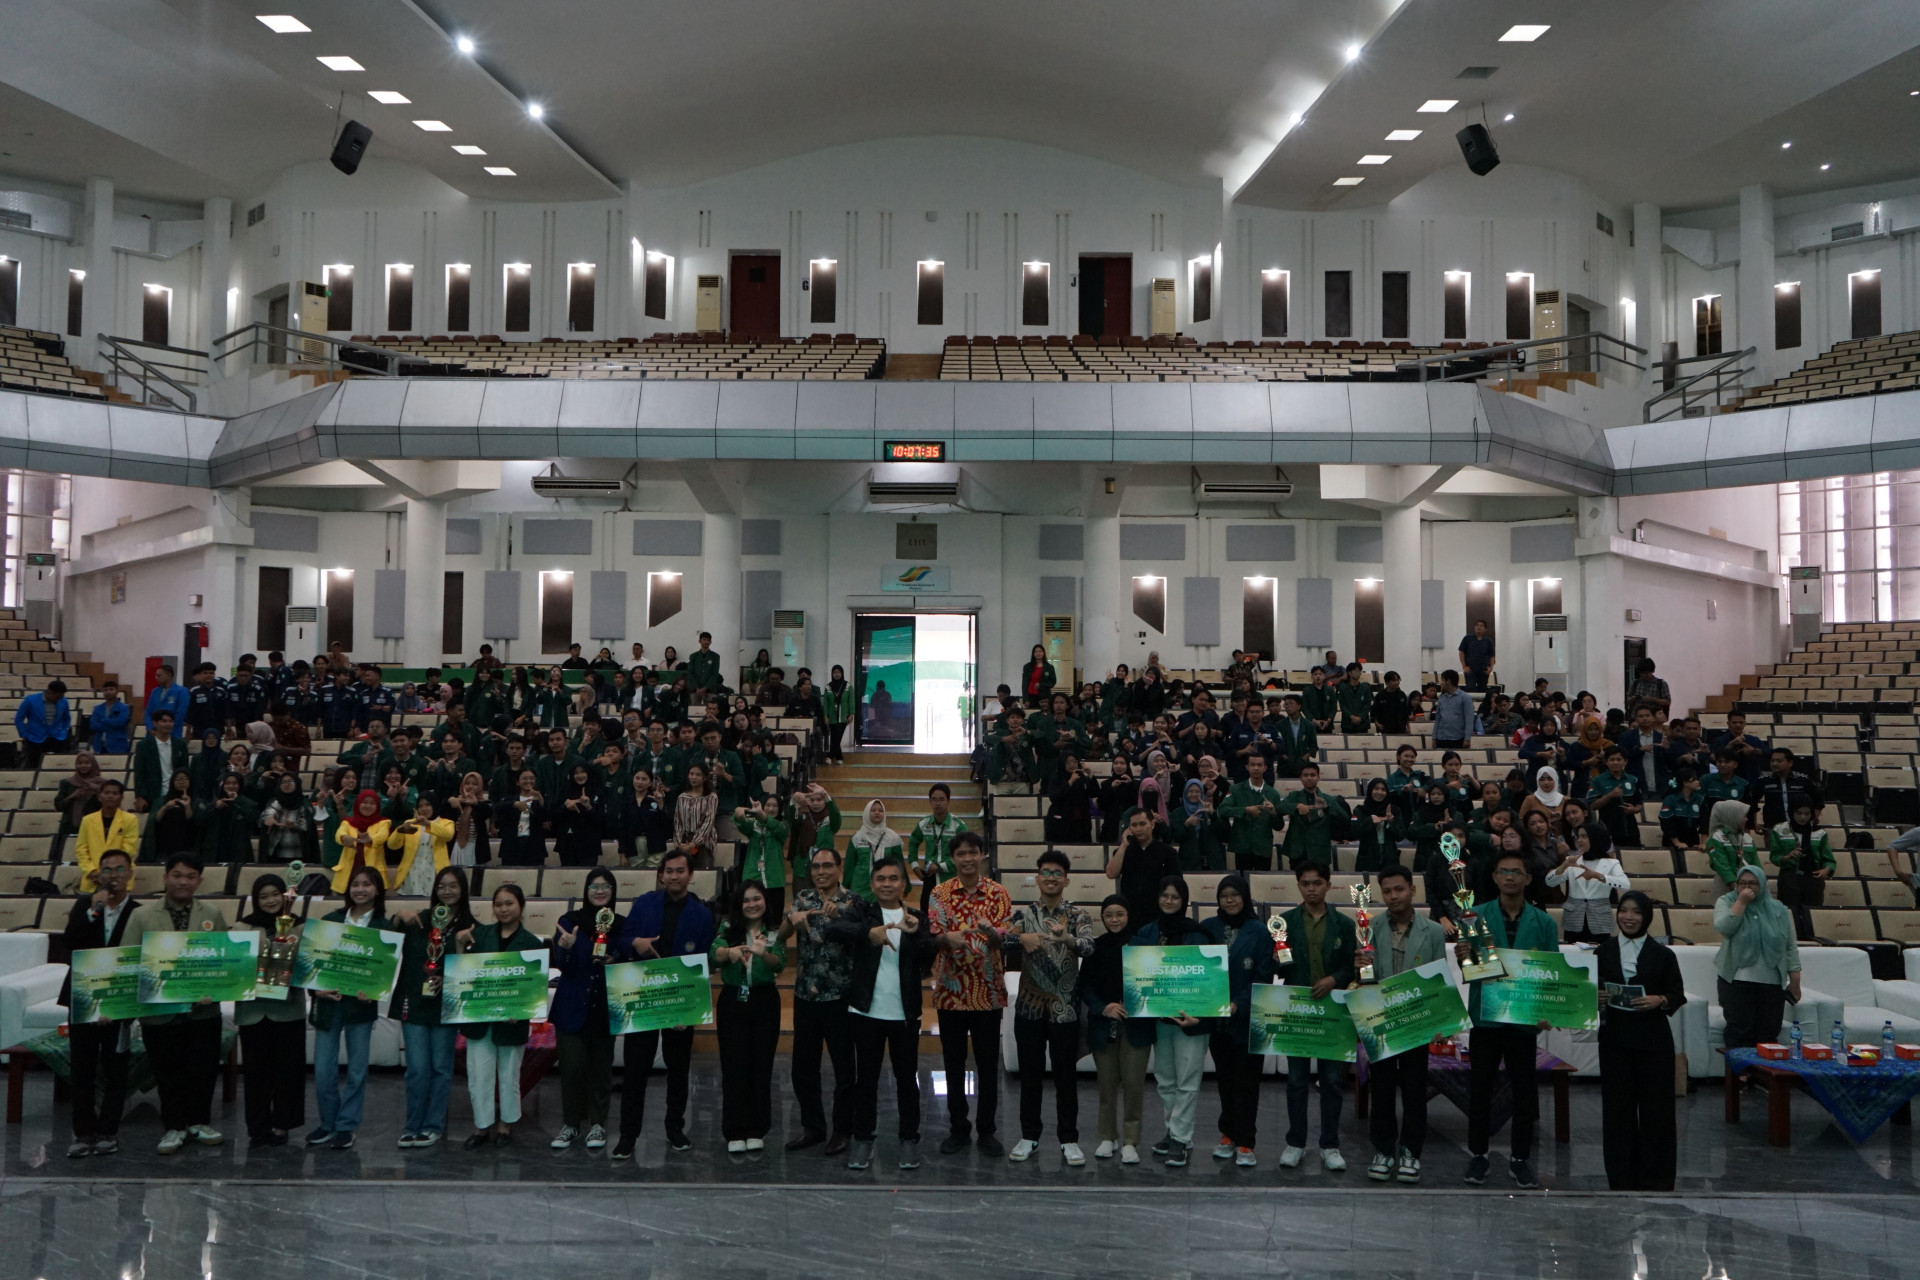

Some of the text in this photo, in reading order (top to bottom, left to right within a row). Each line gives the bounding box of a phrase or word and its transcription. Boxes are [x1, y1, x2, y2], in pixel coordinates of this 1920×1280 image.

[802, 280, 810, 291] G
[1070, 276, 1076, 287] J
[892, 446, 940, 458] 10:07:35
[176, 948, 225, 957] JUARA 1
[329, 940, 374, 956] JUARA 2
[465, 965, 526, 978] BEST PAPER
[1144, 965, 1205, 974] BEST PAPER
[1513, 967, 1559, 980] JUARA 1
[633, 973, 678, 987] JUARA 3
[1376, 989, 1414, 1009] JUARA
[1412, 986, 1422, 997] 2
[1280, 1002, 1325, 1015] JUARA 3
[1398, 1009, 1431, 1025] 750.000,00
